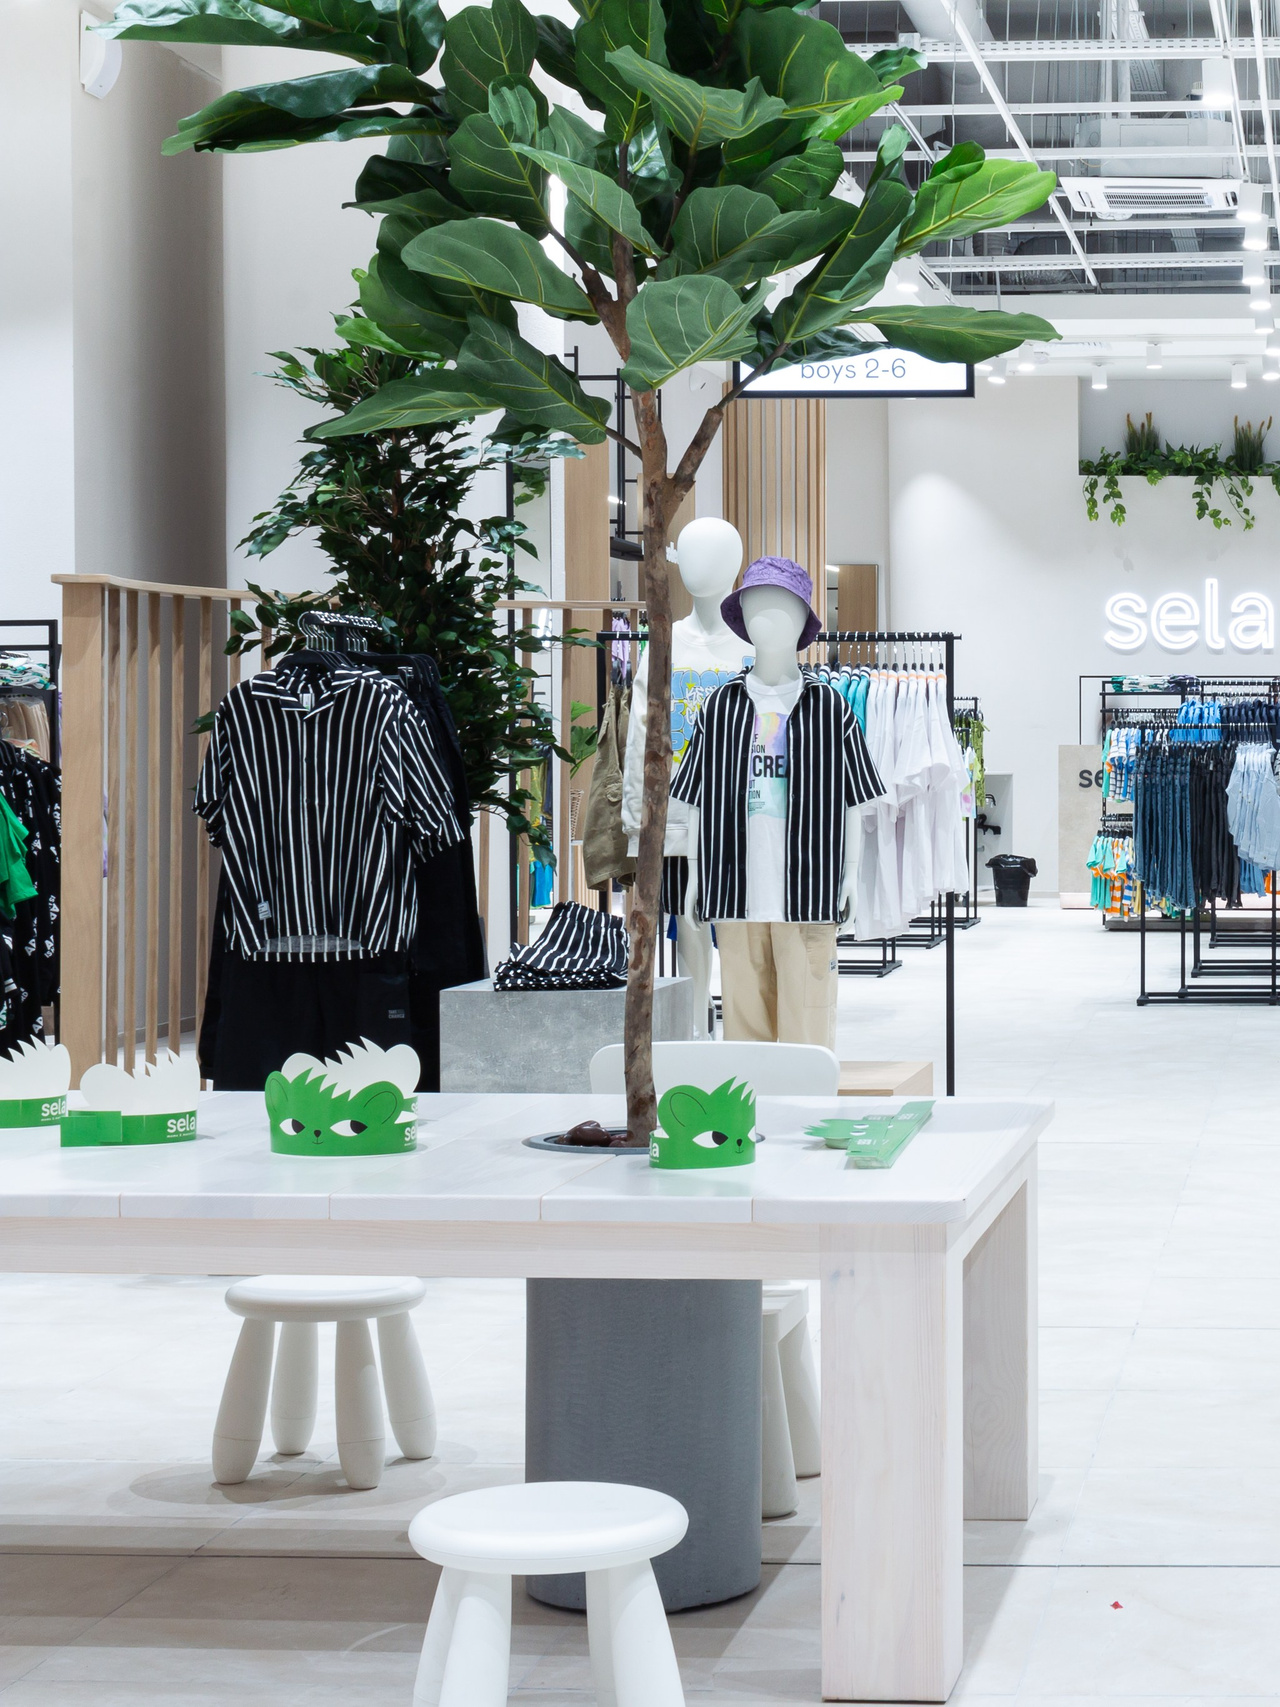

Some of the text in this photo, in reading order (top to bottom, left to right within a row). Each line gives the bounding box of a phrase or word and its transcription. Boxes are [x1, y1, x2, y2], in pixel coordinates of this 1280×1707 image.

[801, 358, 906, 384] boys 2-6
[1103, 578, 1275, 650] sela
[753, 755, 787, 778] CRE
[1079, 769, 1104, 788] se
[41, 1098, 66, 1117] sela
[167, 1113, 196, 1133] sela
[404, 1126, 416, 1141] se
